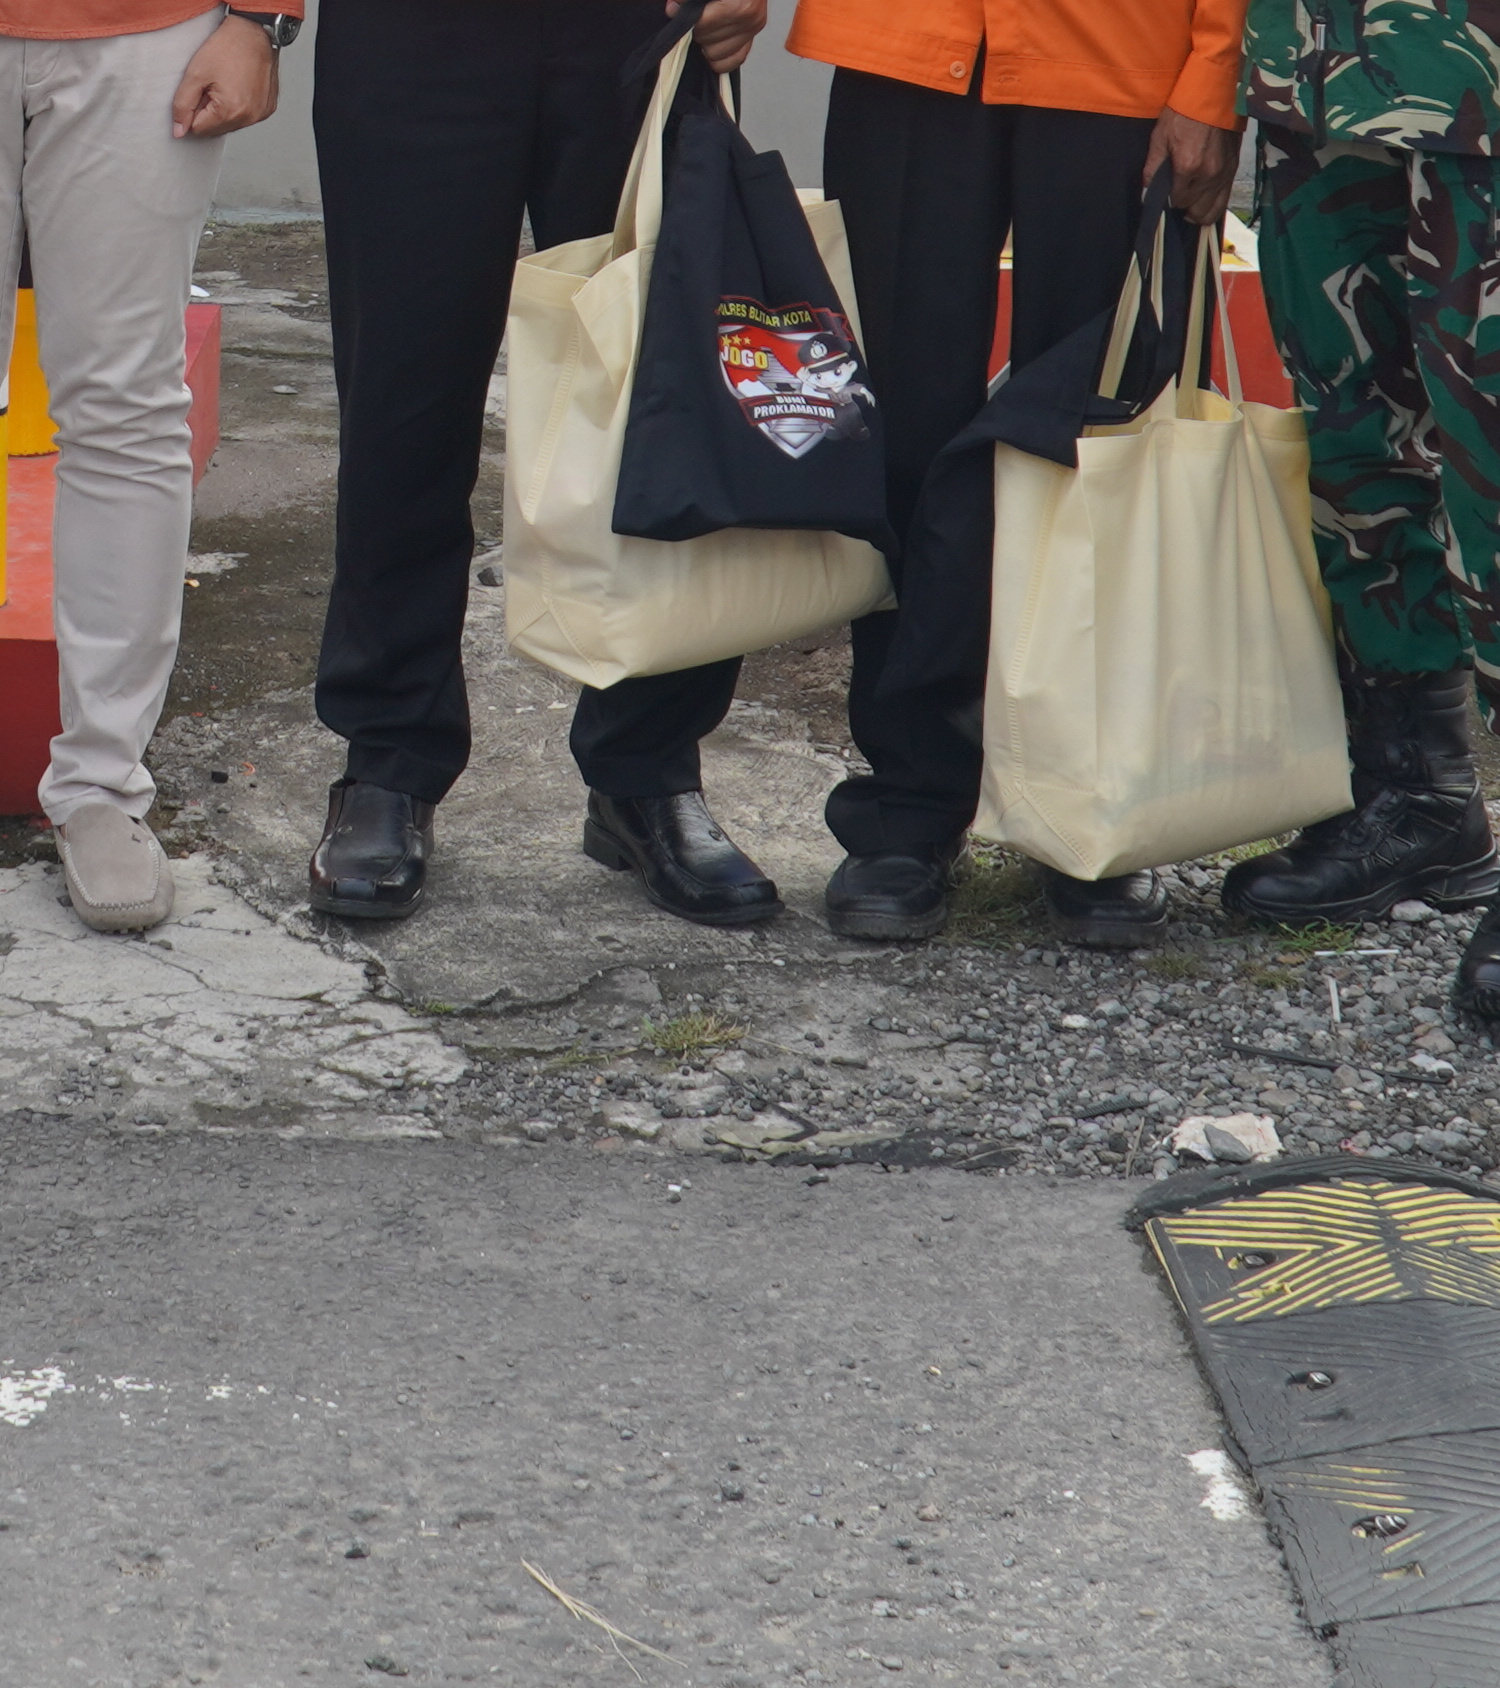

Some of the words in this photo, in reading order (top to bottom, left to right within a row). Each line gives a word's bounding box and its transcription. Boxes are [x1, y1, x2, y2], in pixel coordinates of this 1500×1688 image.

[749, 306, 781, 328] BLITAR
[783, 310, 813, 326] KOTA
[720, 345, 770, 369] JOGO
[775, 395, 806, 405] BUMI
[753, 405, 836, 419] PROKLAMATOR
